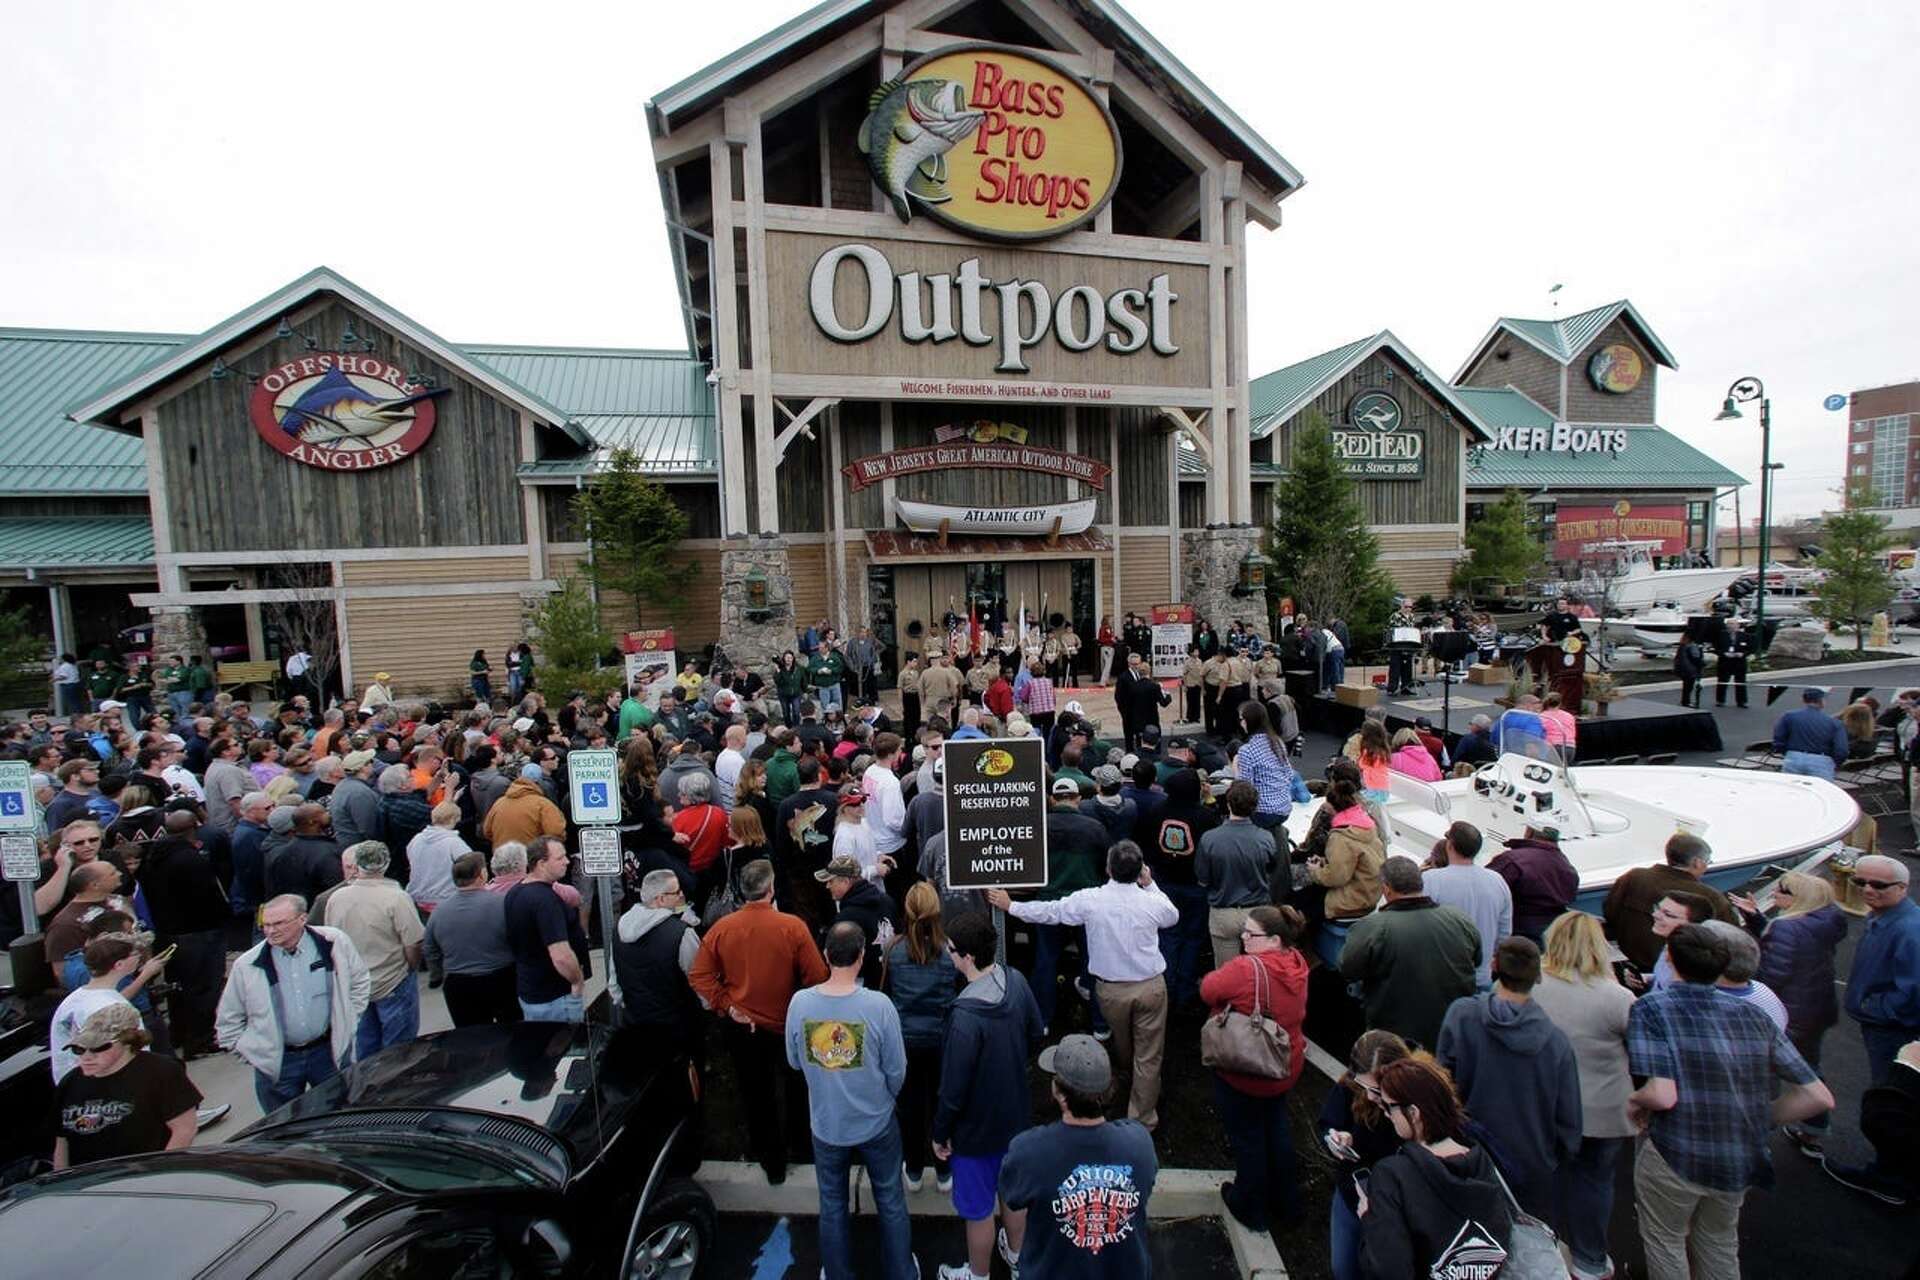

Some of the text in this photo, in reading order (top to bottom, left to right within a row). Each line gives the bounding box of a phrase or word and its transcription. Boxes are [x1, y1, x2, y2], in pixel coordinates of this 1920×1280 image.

[968, 60, 1065, 119] Bass
[973, 111, 1046, 160] Pro
[976, 158, 1091, 219] Shops
[809, 243, 1179, 374] Outpost
[263, 355, 418, 397] OFFSHORE
[900, 381, 944, 394] WELCOME
[1040, 387, 1059, 397] AND
[1061, 387, 1087, 398] OTHER
[1332, 432, 1421, 459] REDHEAD
[1552, 422, 1627, 452] BOATS
[287, 444, 409, 470] ANGLER
[864, 448, 1093, 478] NEW JERSEY'S GREAT AMERICAN OUTDOOR STORE
[964, 509, 1047, 523] ATLANTIC CITY
[572, 757, 613, 768] RESERVED
[575, 770, 611, 780] PARKING
[953, 781, 1036, 795] SPECIAL PARKING
[961, 796, 1030, 809] RESERVED FOR
[960, 826, 1033, 841] EMPLOYEE
[981, 844, 1013, 855] of the
[971, 858, 1024, 872] MONTH
[1062, 1168, 1132, 1190] UNION
[1052, 1187, 1140, 1215] CARPENTERS
[1060, 1222, 1134, 1248] SOLIDARITY
